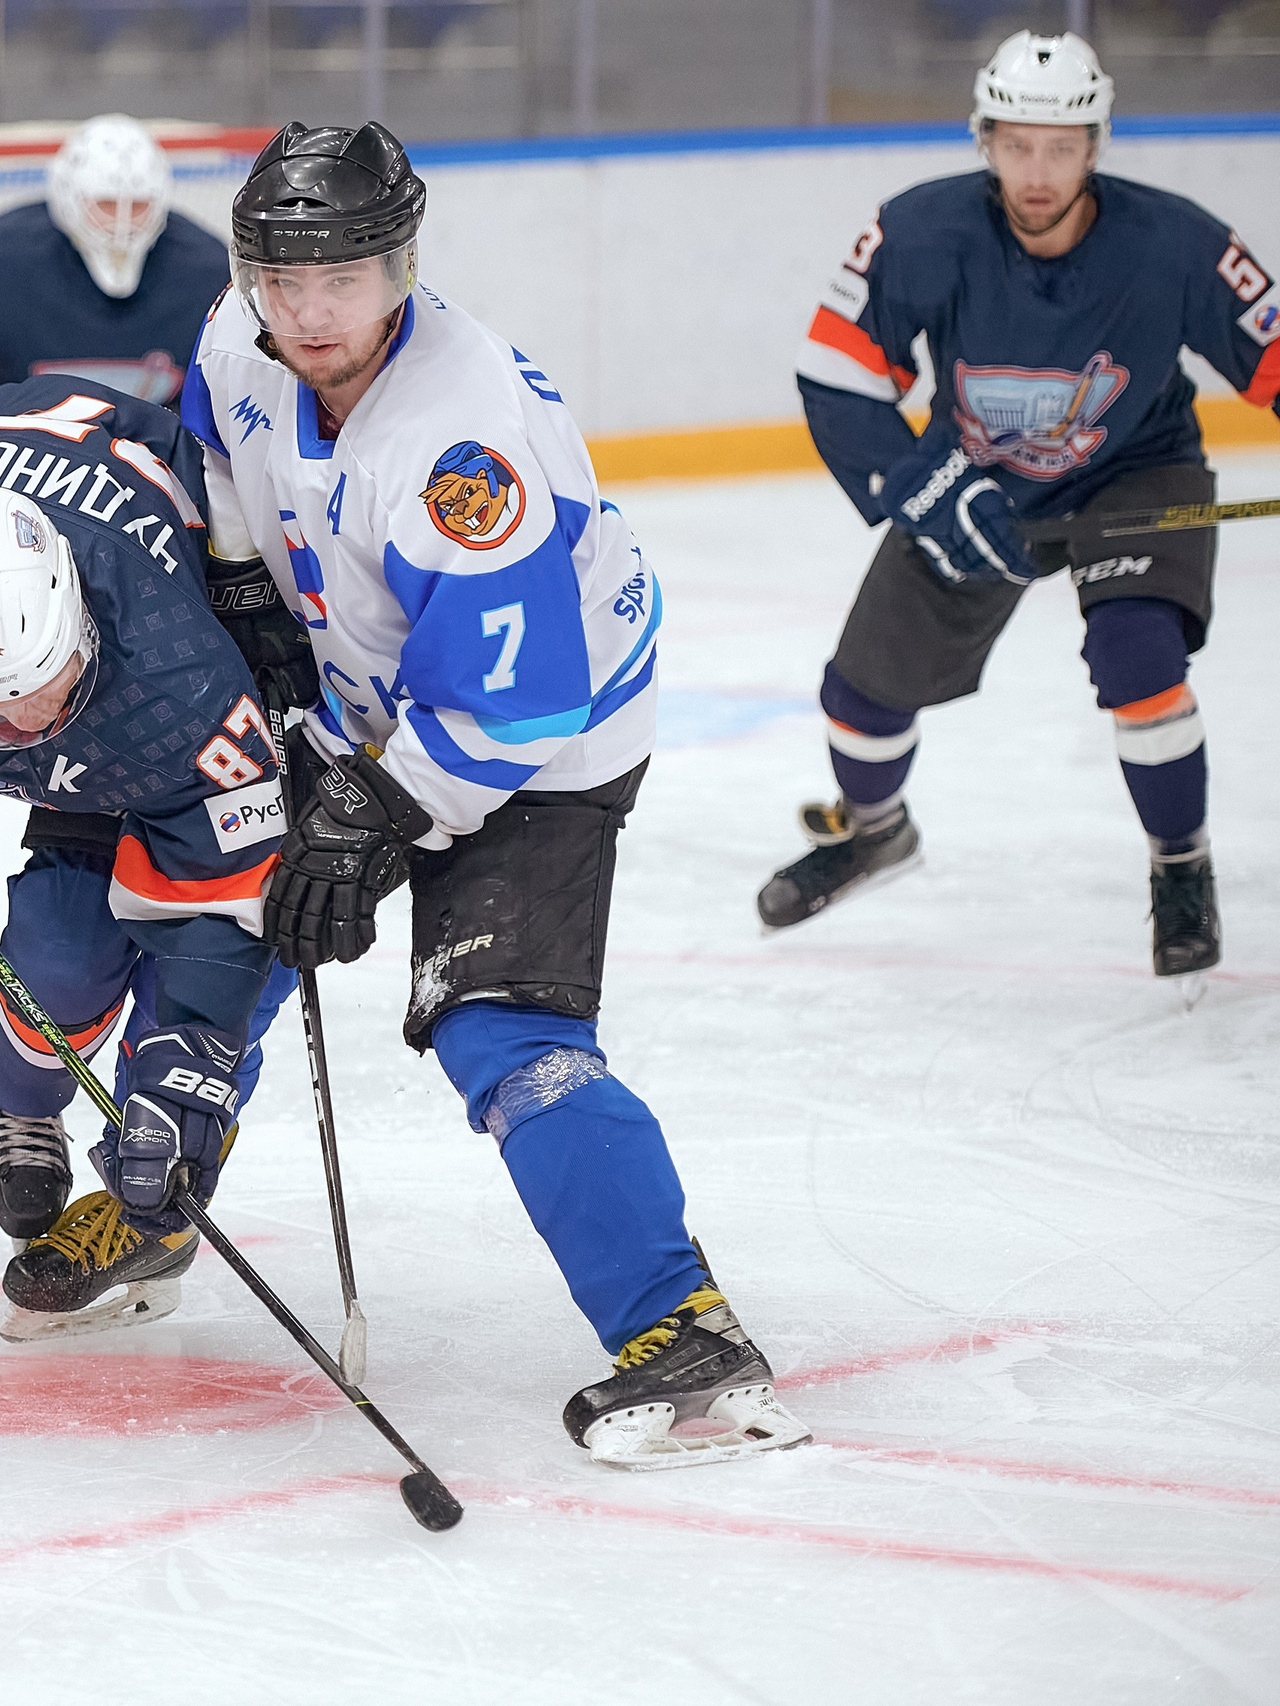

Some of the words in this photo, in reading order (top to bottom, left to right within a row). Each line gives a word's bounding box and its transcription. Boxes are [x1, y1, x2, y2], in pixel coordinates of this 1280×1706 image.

[480, 600, 527, 694] 7
[196, 693, 280, 790] 87
[240, 793, 284, 825] РусГ
[157, 1066, 240, 1116] BAU
